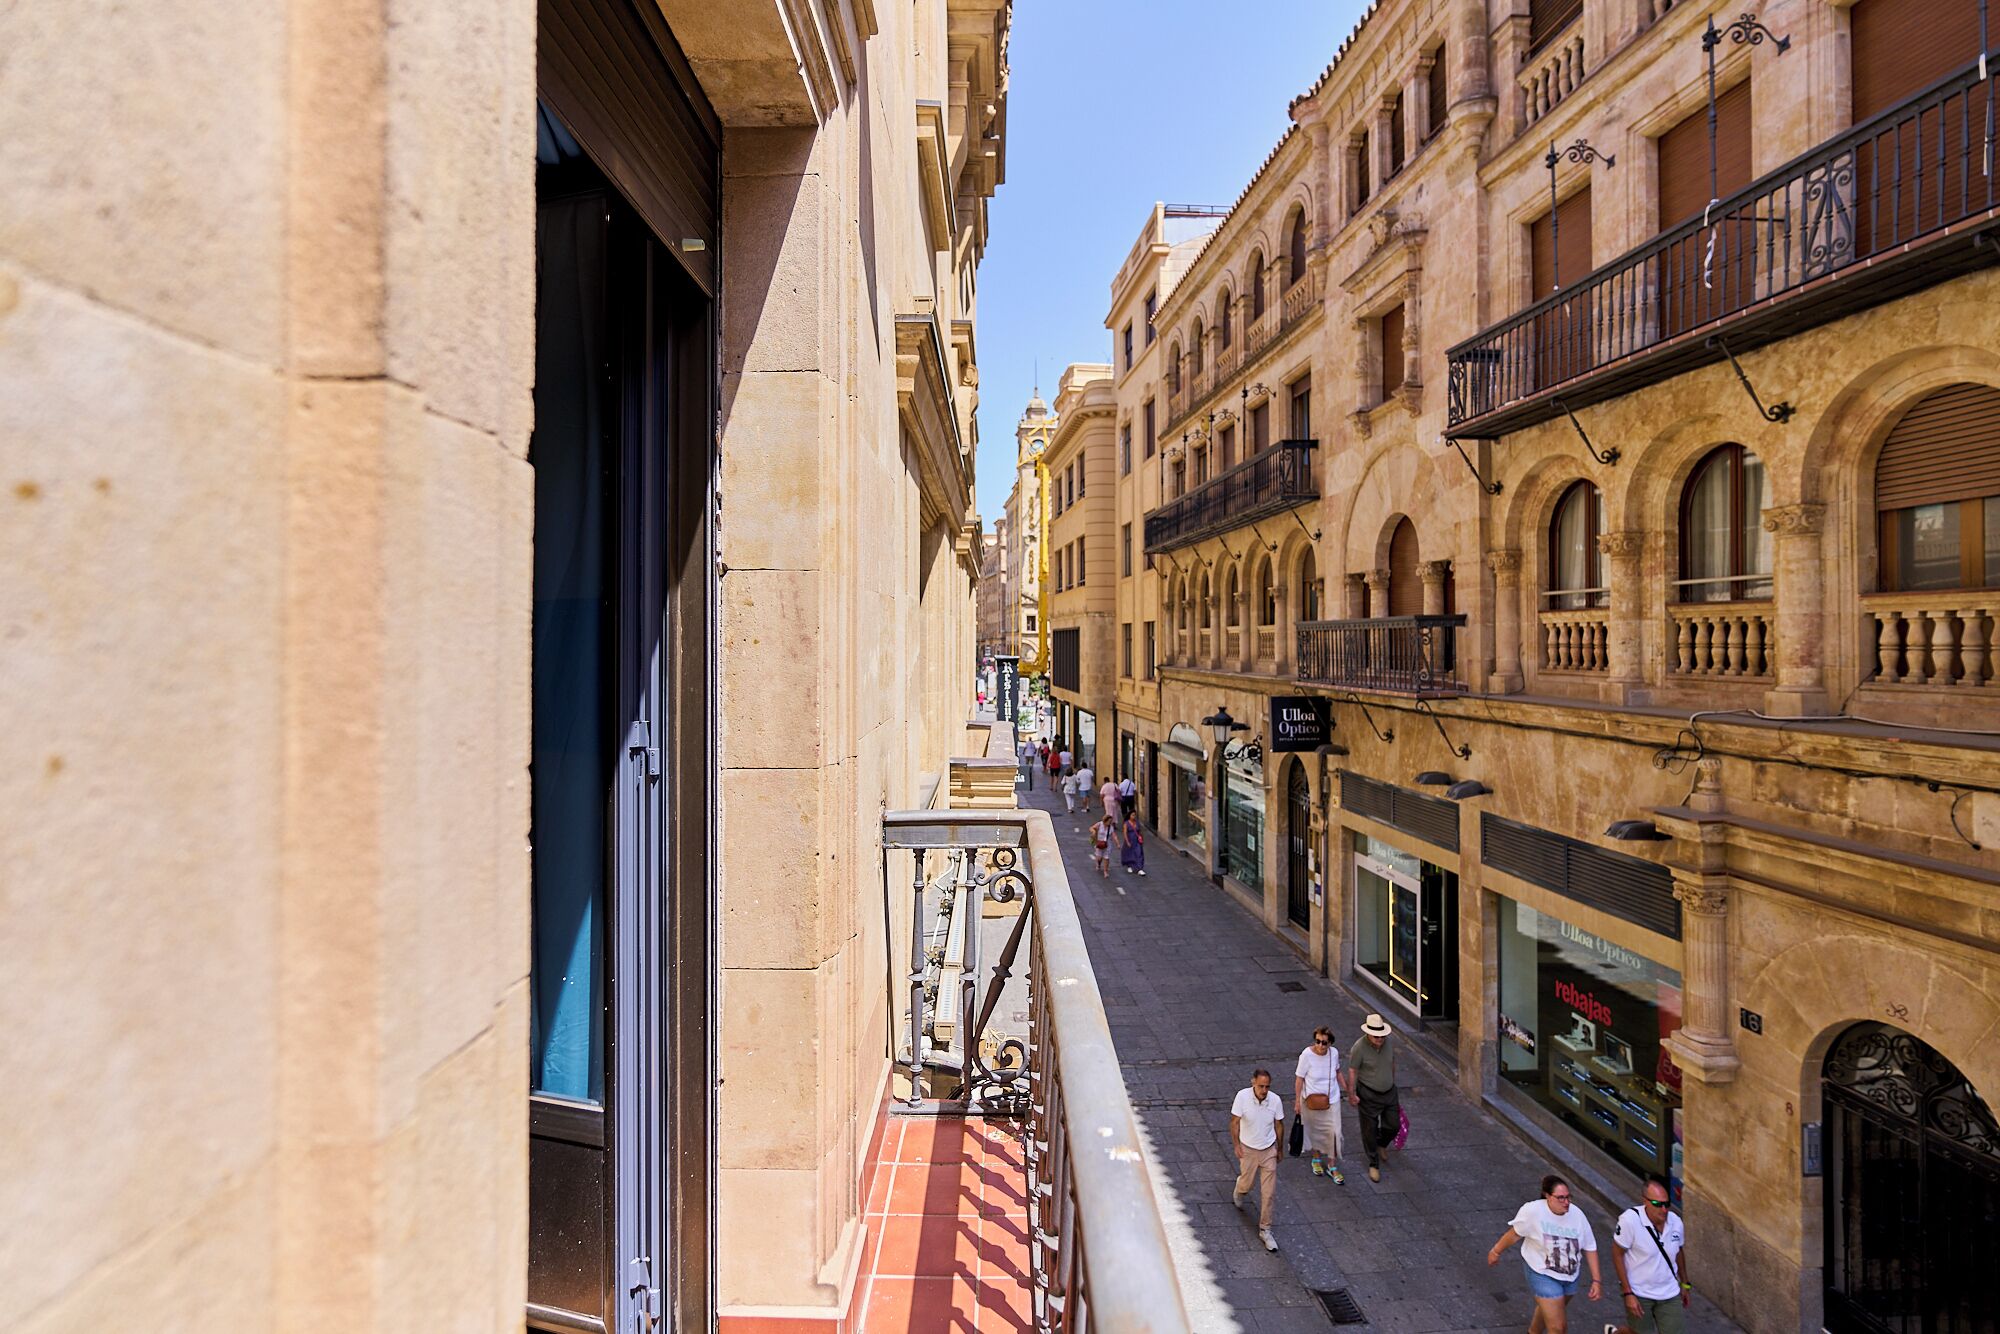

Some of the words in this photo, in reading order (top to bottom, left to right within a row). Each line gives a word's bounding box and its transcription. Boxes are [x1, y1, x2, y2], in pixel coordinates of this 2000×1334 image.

[1282, 708, 1316, 721] Ulloa
[1278, 721, 1320, 738] Optico
[1560, 920, 1593, 949] Ulloa
[1596, 936, 1641, 969] Optico
[1555, 980, 1613, 1027] rebajas
[1741, 1009, 1760, 1032] 16
